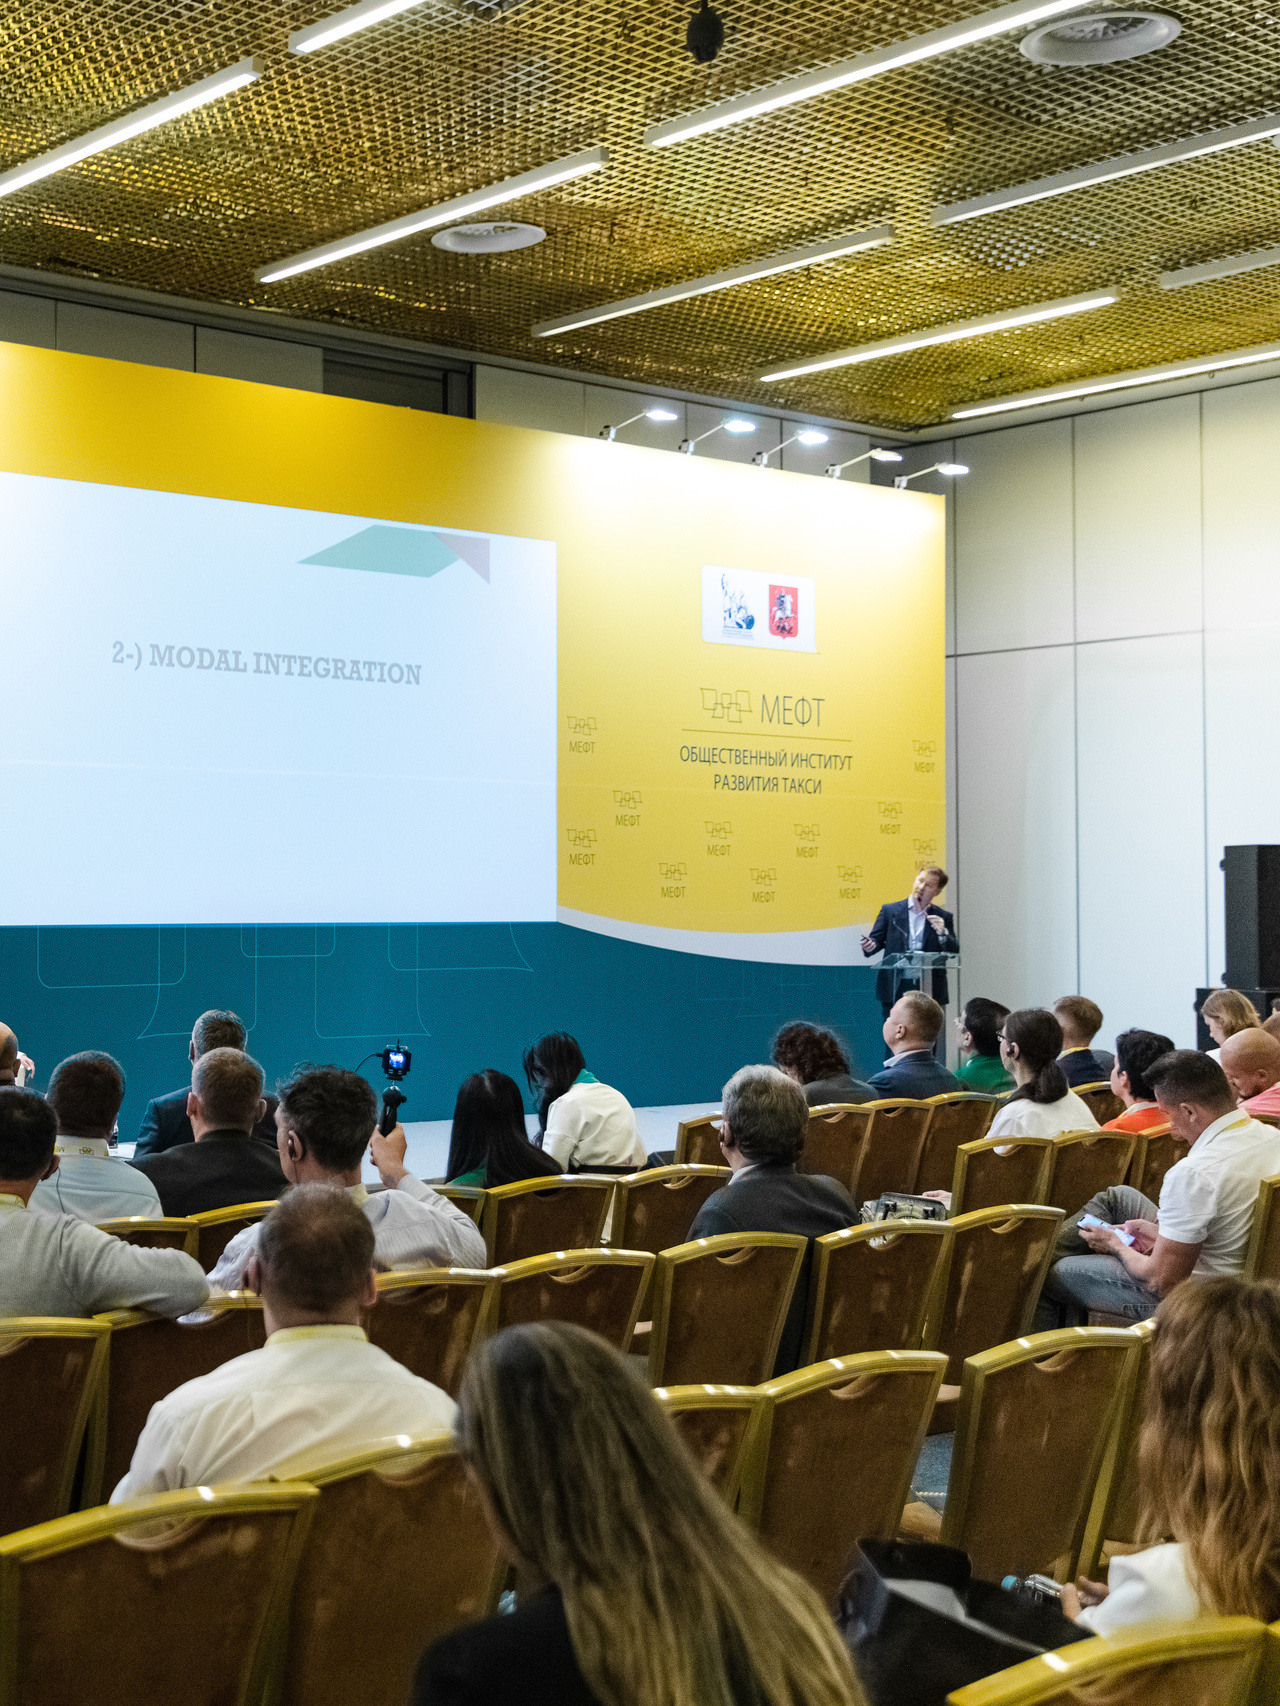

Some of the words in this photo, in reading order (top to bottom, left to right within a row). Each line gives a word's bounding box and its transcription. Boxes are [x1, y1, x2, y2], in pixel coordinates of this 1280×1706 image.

[112, 640, 142, 671] 2-)
[149, 643, 247, 673] MODAL
[253, 651, 422, 685] INTEGRATION
[761, 694, 825, 728] МЕФТ
[569, 741, 596, 754] МЕФТ
[679, 745, 788, 767] ОБЩЕСТВЕННЫЙ
[791, 753, 853, 771] ИНСТИТУТ
[714, 773, 779, 792] РАЗВИТИЯ
[782, 777, 822, 794] ТАКСИ
[615, 814, 641, 827] МЕФТ
[707, 844, 731, 857] МЕФТ
[796, 847, 819, 859] МЕФТ
[569, 853, 596, 866] МЕФТ
[661, 886, 686, 898] МЕФТ
[752, 891, 776, 903] МЕФТ
[840, 888, 862, 899] МЕФТ
